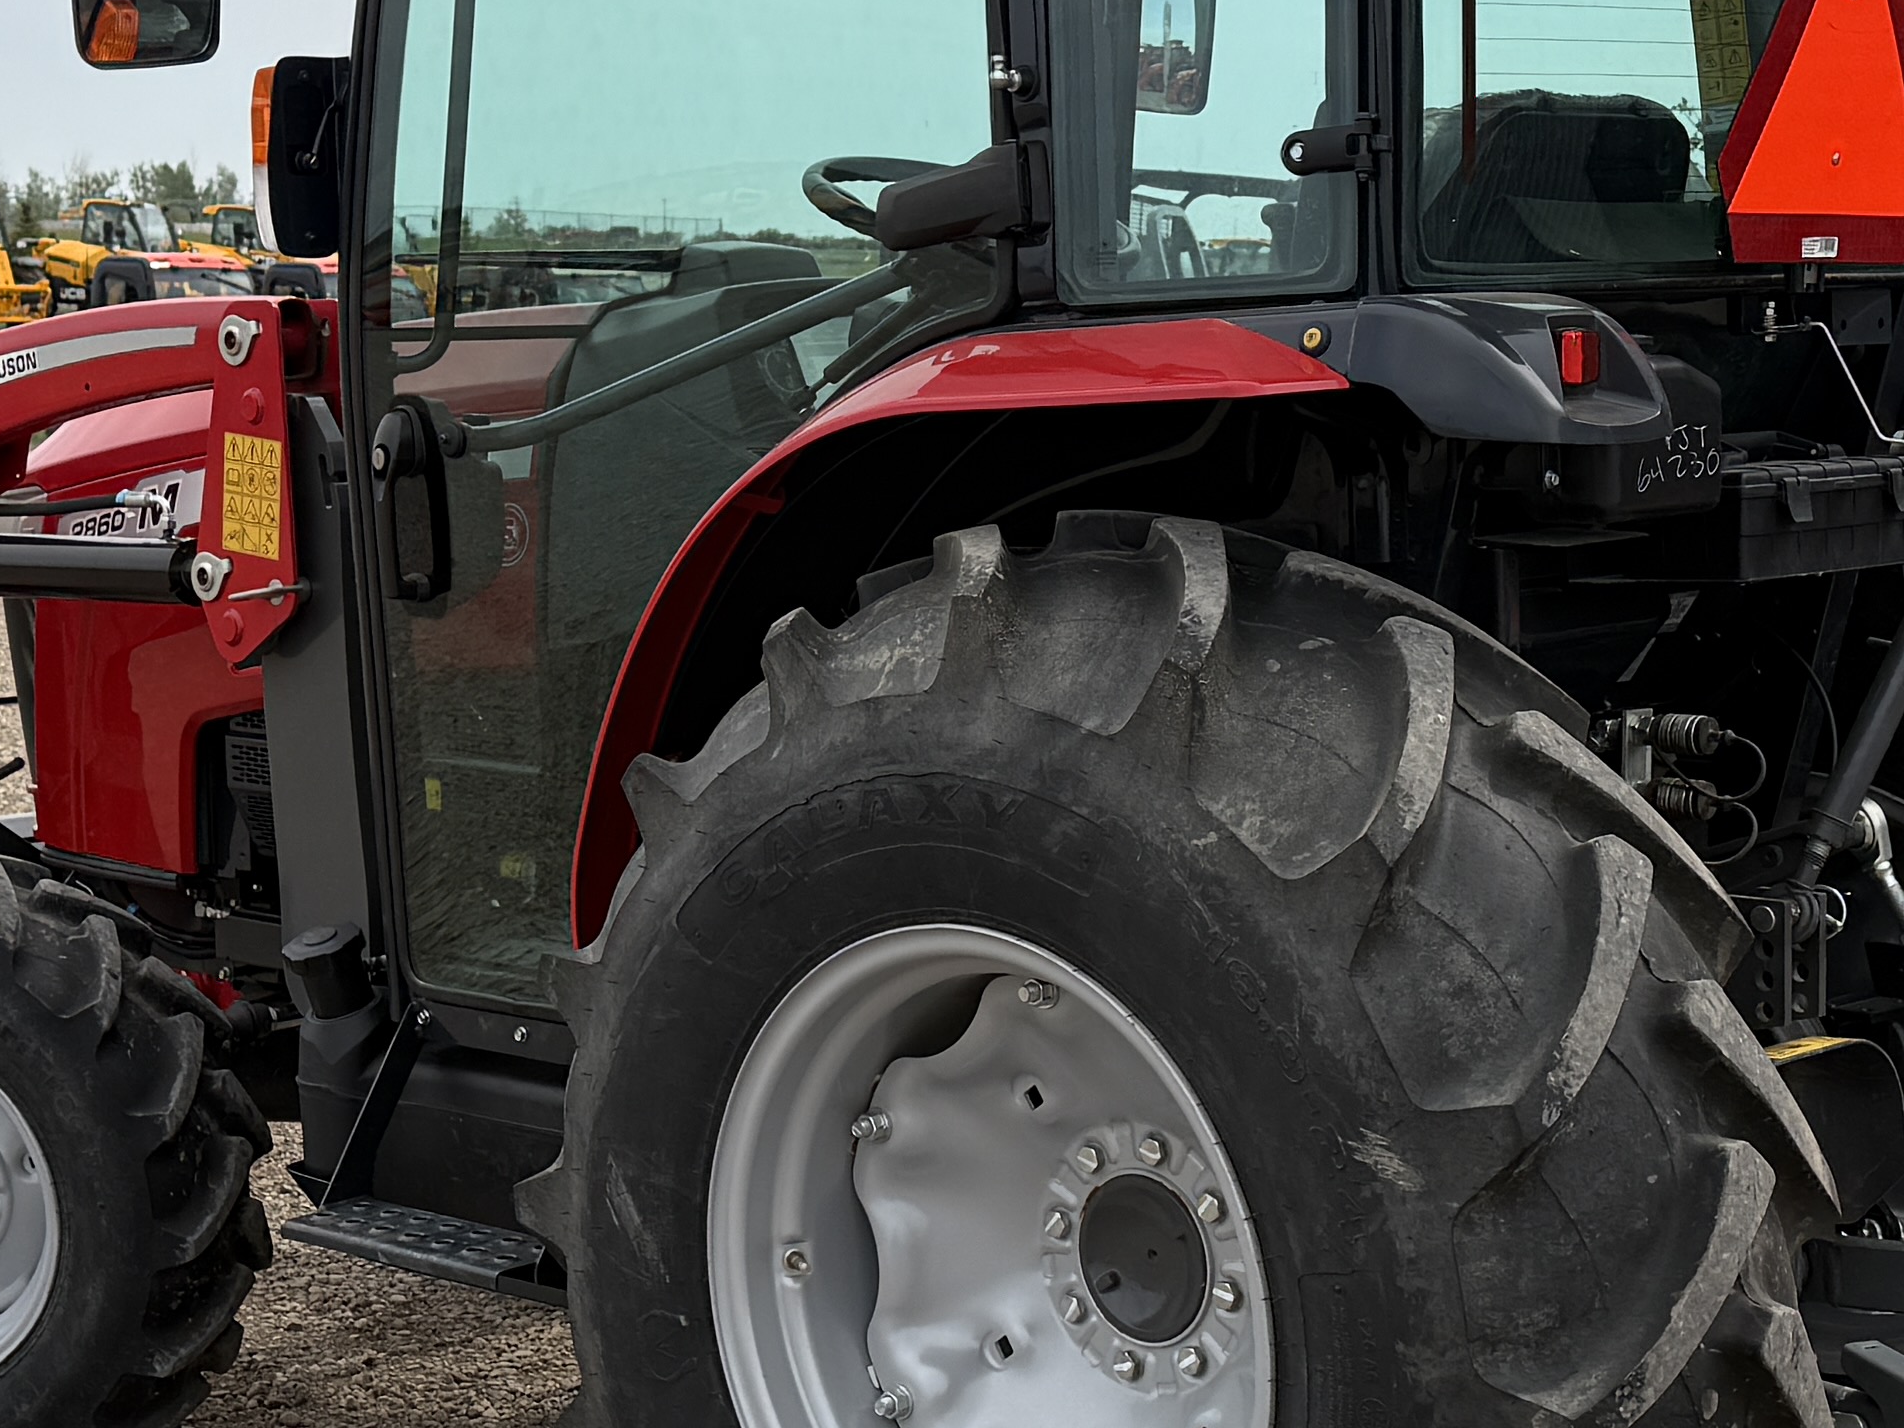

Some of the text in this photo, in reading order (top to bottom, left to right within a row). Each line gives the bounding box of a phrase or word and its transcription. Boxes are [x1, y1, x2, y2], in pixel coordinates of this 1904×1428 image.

[60, 287, 86, 301] JCB
[1637, 448, 1721, 493] 64230
[717, 781, 1028, 909] GALAXY
